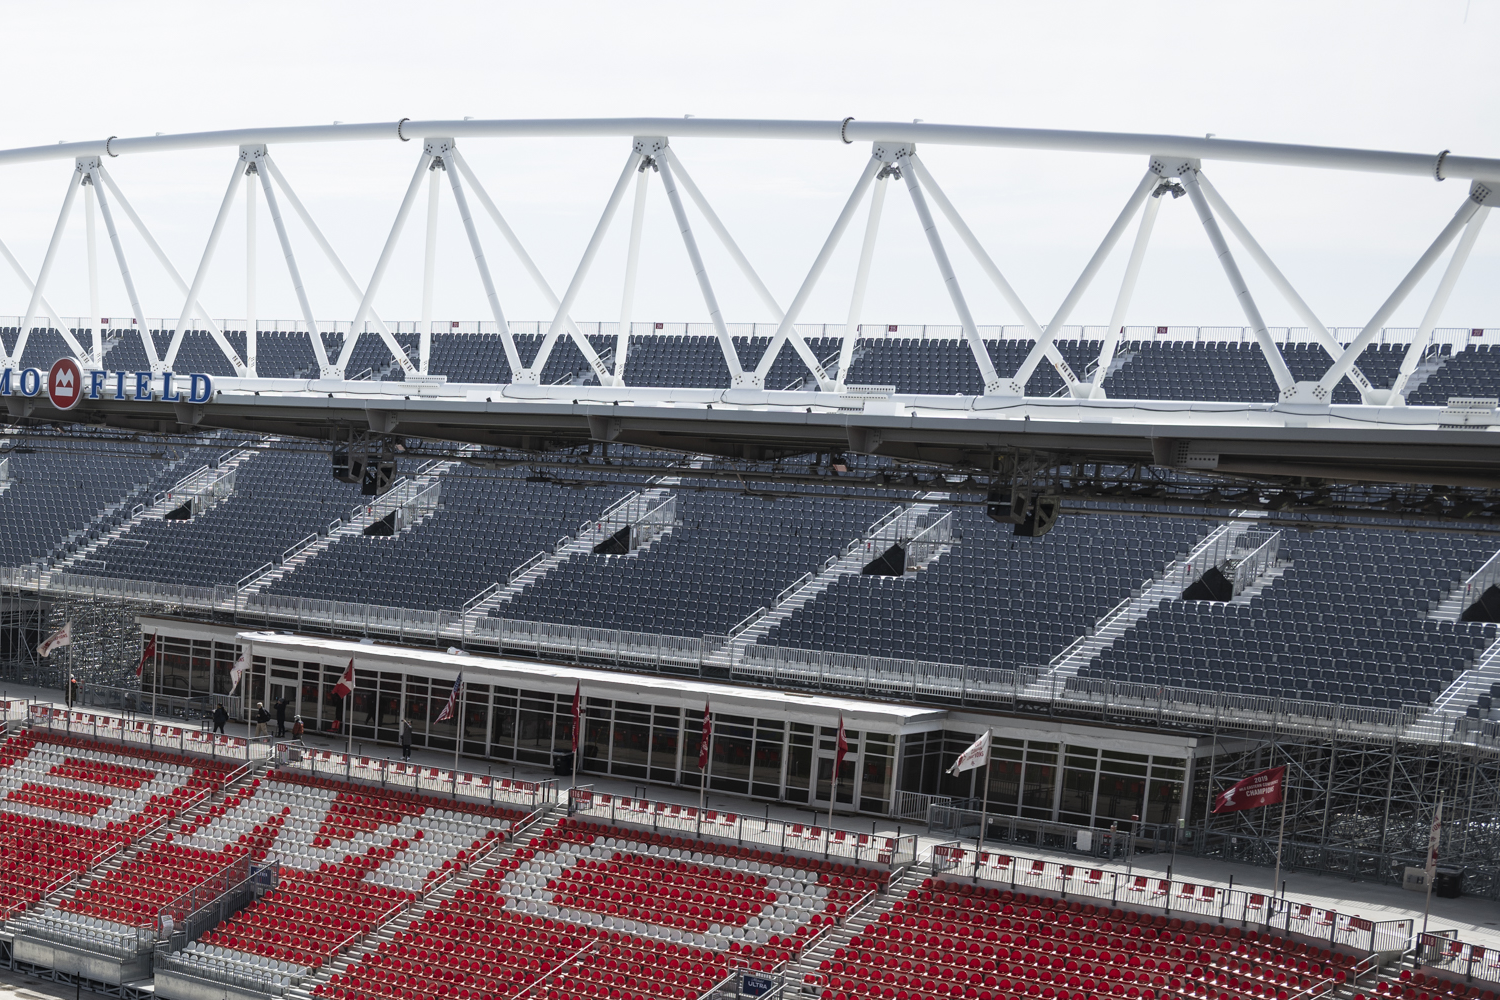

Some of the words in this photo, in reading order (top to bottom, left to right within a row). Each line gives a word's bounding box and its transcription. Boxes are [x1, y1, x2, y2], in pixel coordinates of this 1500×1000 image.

[89, 370, 214, 403] FIELD
[1254, 775, 1268, 784] 2019
[748, 981, 768, 990] ULTRA
